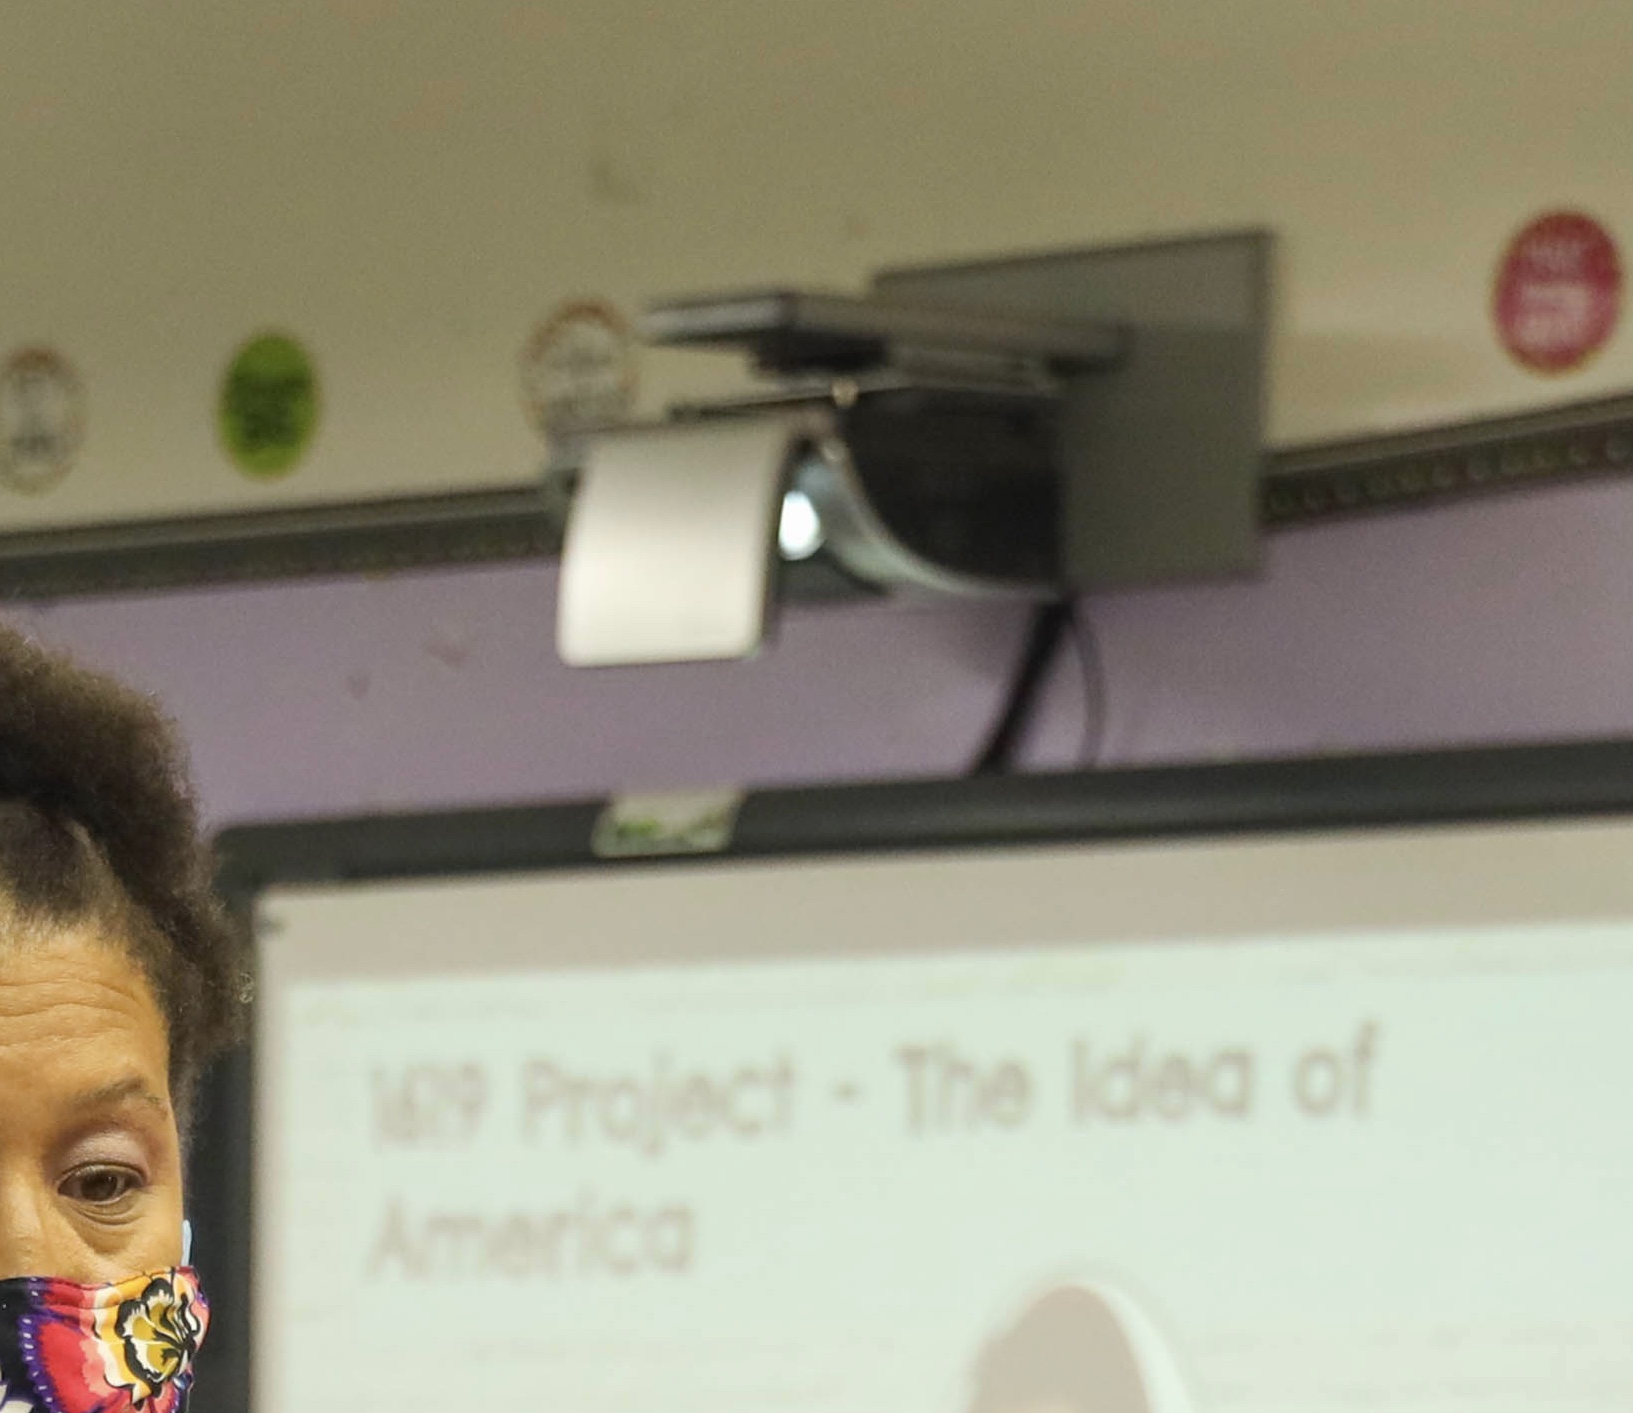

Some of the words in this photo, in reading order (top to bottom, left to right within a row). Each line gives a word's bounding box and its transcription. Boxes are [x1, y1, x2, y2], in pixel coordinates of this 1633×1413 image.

[520, 1050, 796, 1158] Project
[894, 1043, 1031, 1138] The
[1072, 1037, 1254, 1124] Idea
[1291, 1021, 1383, 1116] of
[371, 1194, 694, 1280] America
